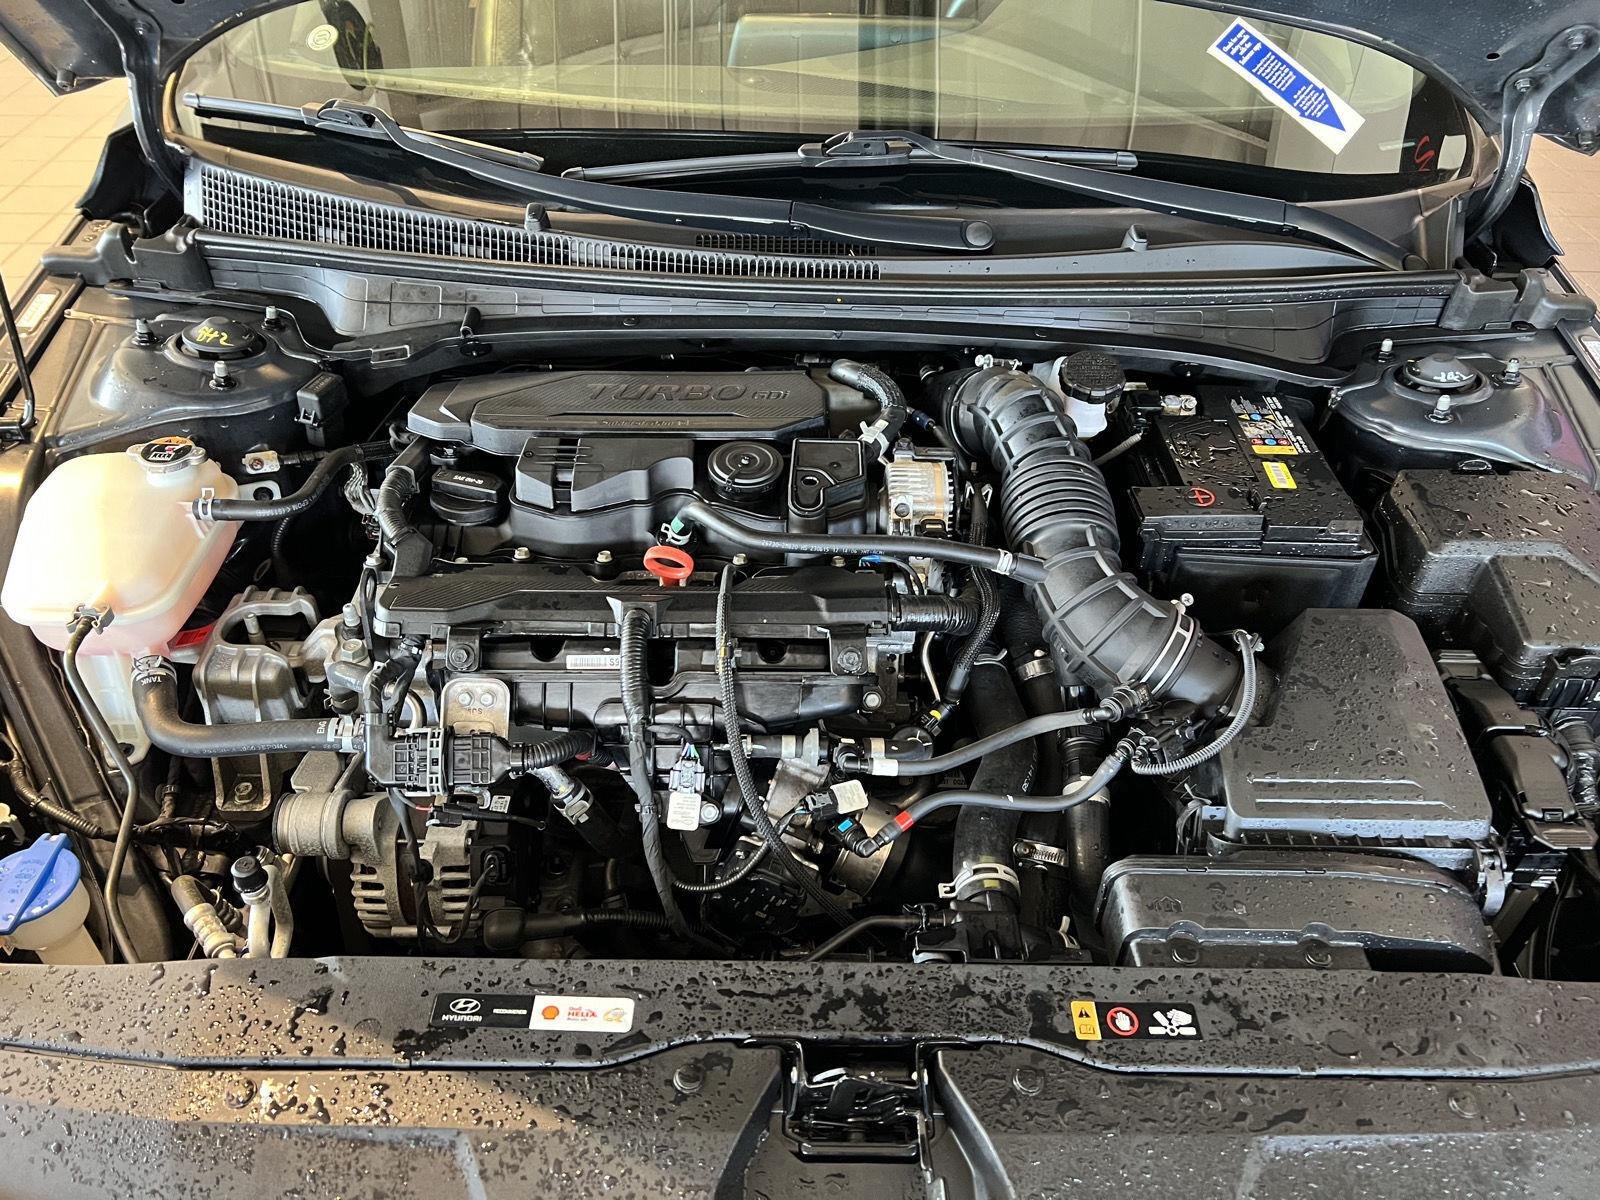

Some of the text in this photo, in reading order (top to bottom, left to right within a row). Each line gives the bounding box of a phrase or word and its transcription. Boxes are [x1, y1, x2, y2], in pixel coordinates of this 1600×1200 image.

[587, 383, 749, 402] TURBO
[140, 675, 161, 686] TANK
[316, 719, 327, 734] ENG
[441, 1014, 482, 1022] HYUNDAI
[567, 1010, 598, 1018] HELIX
